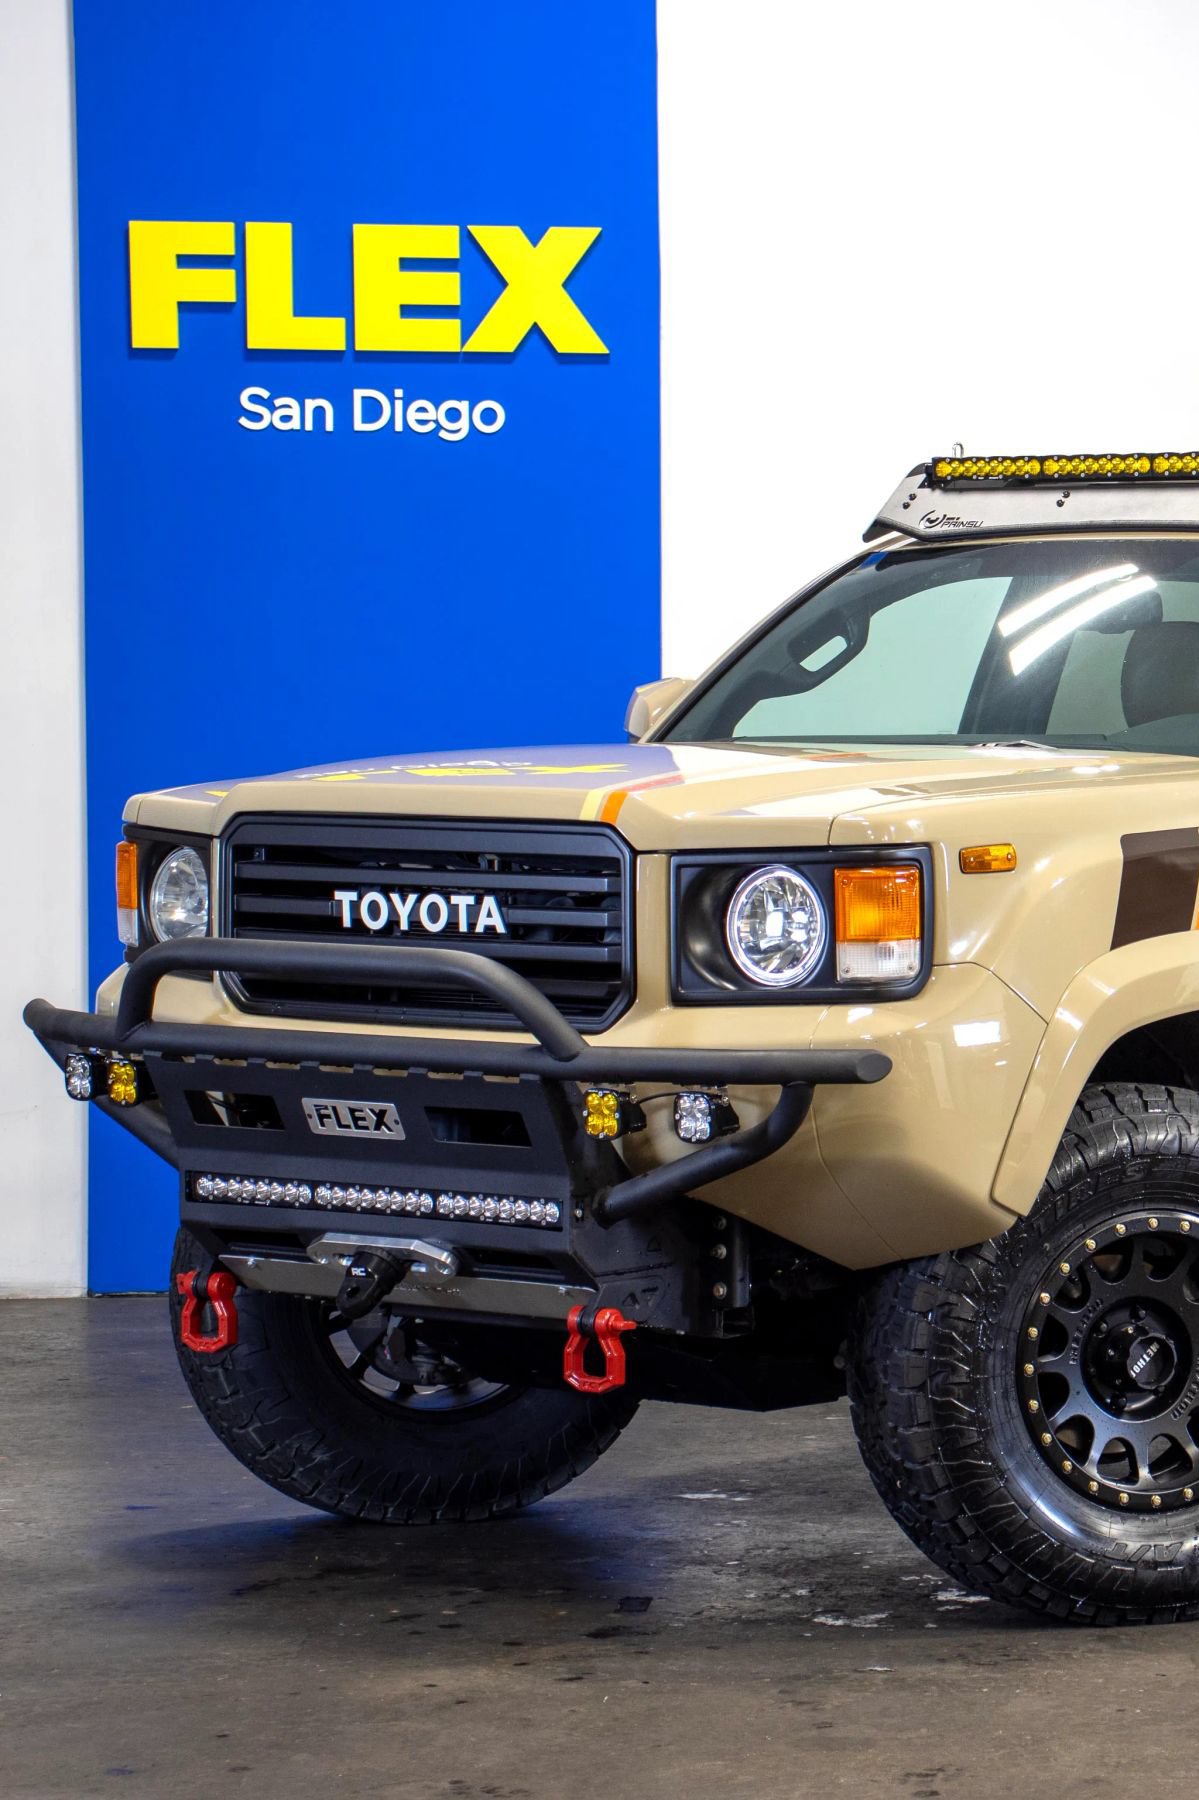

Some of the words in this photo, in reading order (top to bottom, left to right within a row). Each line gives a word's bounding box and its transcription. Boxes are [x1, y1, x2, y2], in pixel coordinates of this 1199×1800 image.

[129, 220, 610, 354] FLEX
[238, 387, 334, 432] San
[353, 388, 506, 441] Diego
[334, 890, 507, 934] TOYOTA
[313, 1104, 395, 1133] FLEX
[351, 1267, 366, 1277] RC
[1104, 1542, 1184, 1563] A/T
